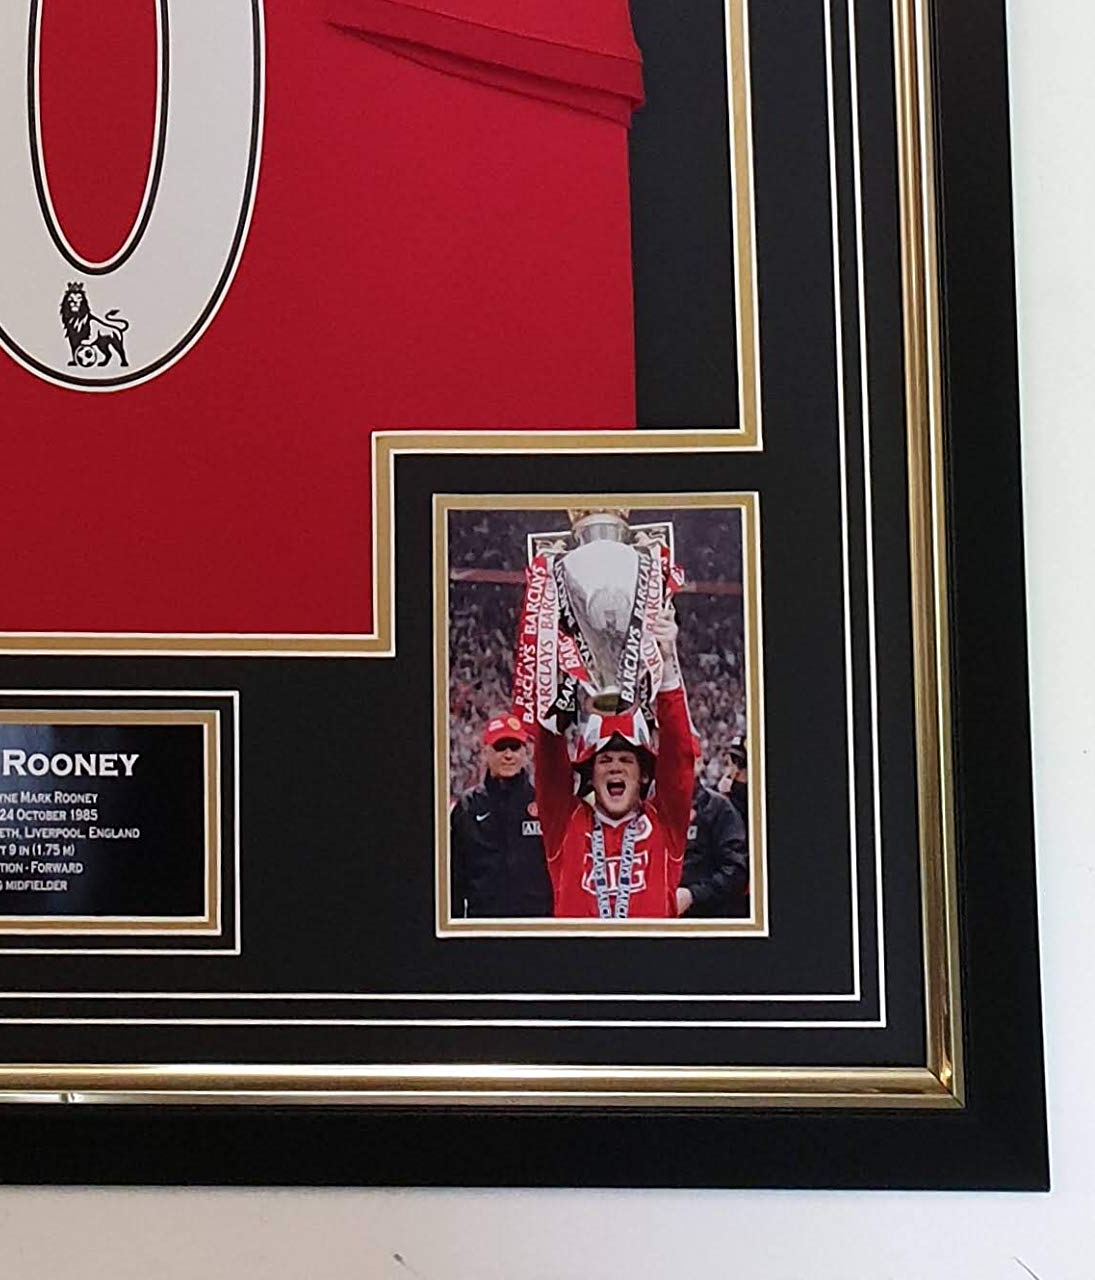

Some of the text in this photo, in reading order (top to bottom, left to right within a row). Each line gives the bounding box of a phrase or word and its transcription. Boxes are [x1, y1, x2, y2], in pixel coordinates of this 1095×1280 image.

[522, 564, 546, 724] BARCLAYS BARCLAYS
[621, 625, 641, 703] BARCLAYS
[0, 809, 14, 821] 24
[70, 809, 98, 821] 1985
[8, 843, 17, 856] 9
[32, 843, 60, 856] (1.75
[5, 880, 68, 890] MIDFIELDER
